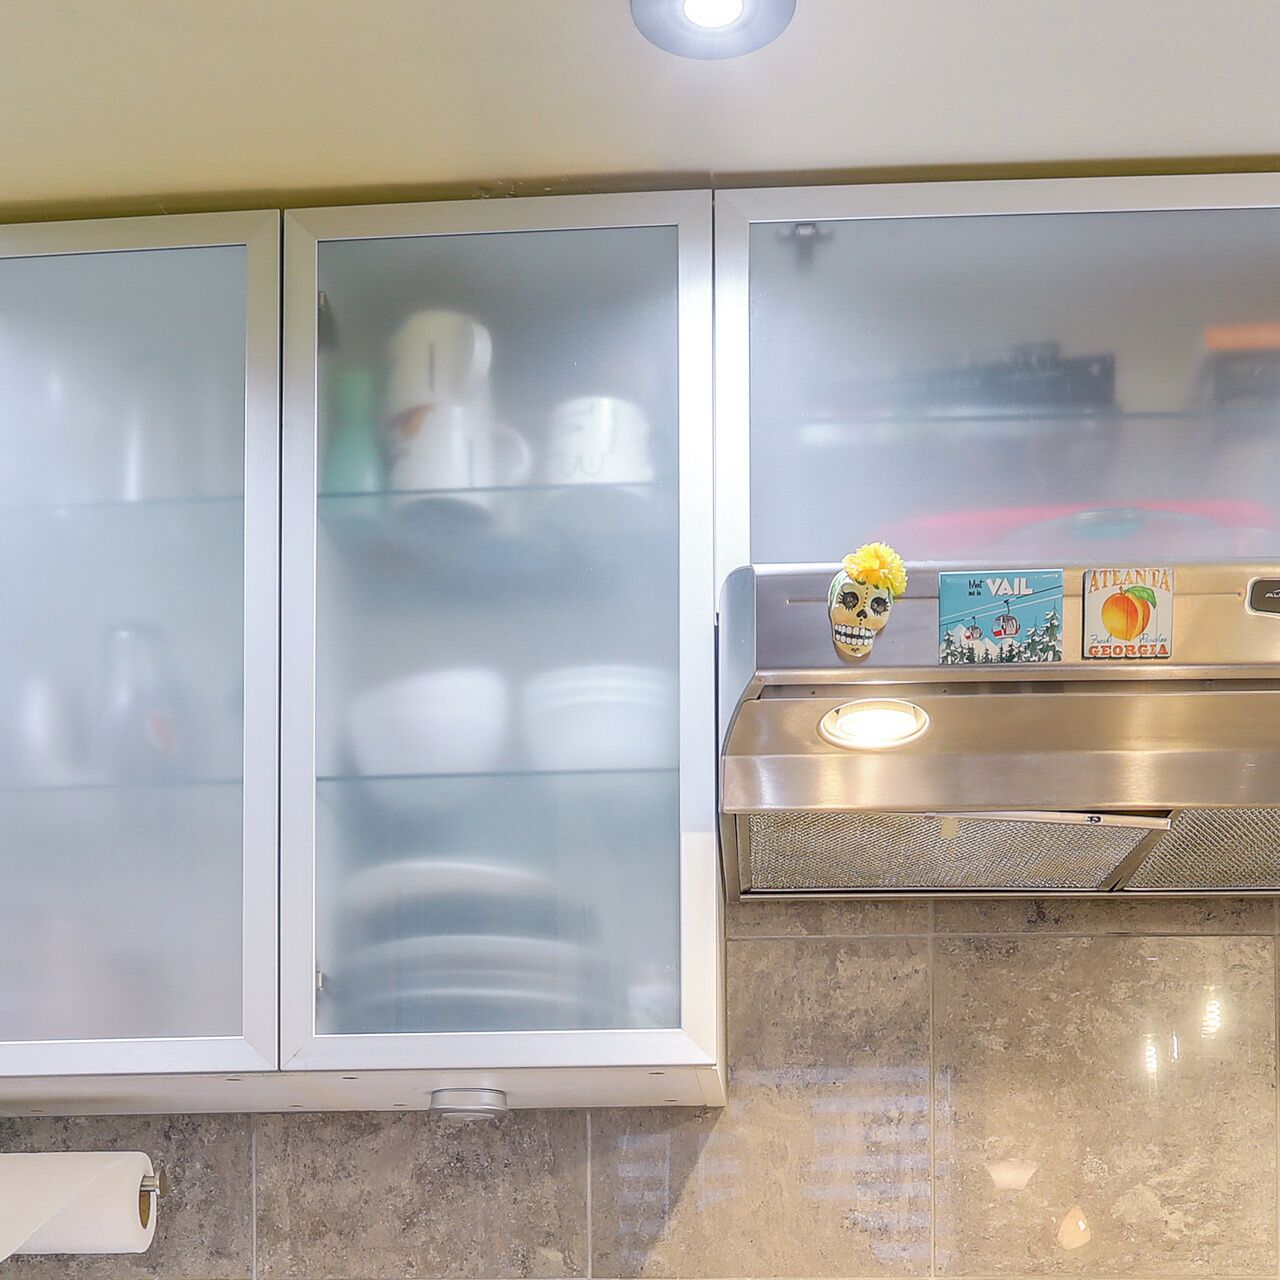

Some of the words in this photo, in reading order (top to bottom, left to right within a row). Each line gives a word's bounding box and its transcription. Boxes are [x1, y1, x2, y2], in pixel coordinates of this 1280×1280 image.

[986, 577, 1034, 596] VAIL
[1088, 569, 1171, 594] ATLANTA
[1088, 644, 1169, 656] GEORGIA
